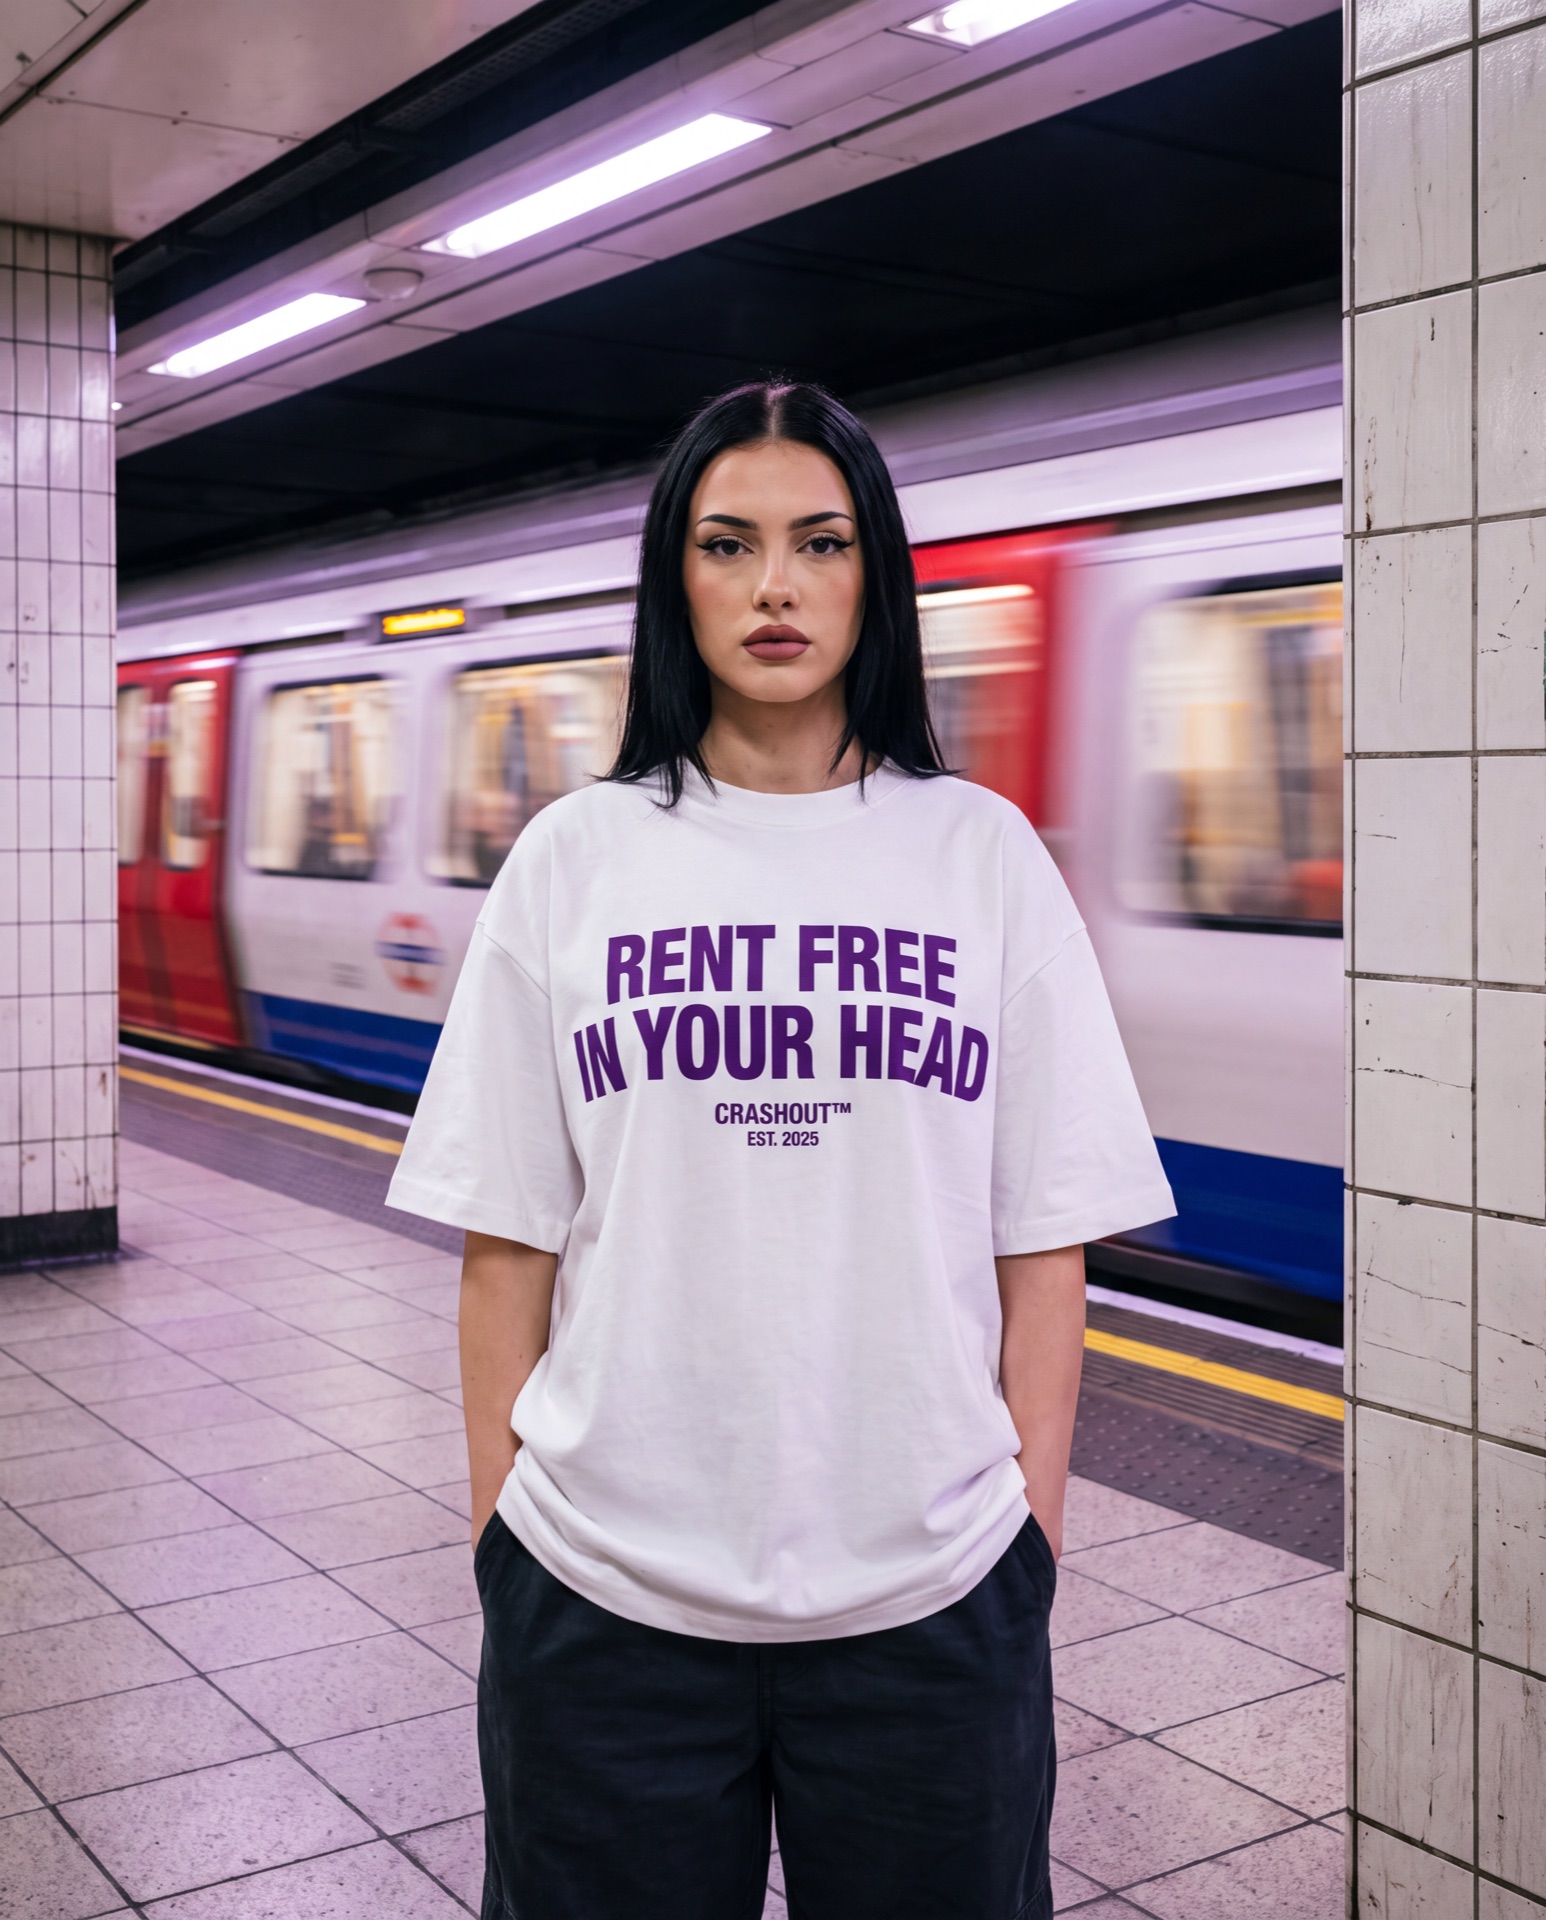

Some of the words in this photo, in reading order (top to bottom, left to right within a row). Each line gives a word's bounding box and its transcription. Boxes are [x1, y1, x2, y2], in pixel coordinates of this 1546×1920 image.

[606, 924, 776, 1005] RENT
[798, 924, 957, 1008] FREE
[573, 1016, 628, 1103] IN
[632, 1003, 816, 1081] YOUR
[839, 1004, 989, 1102] HEAD
[747, 1130, 778, 1147] EST.
[781, 1130, 820, 1147] 2025
